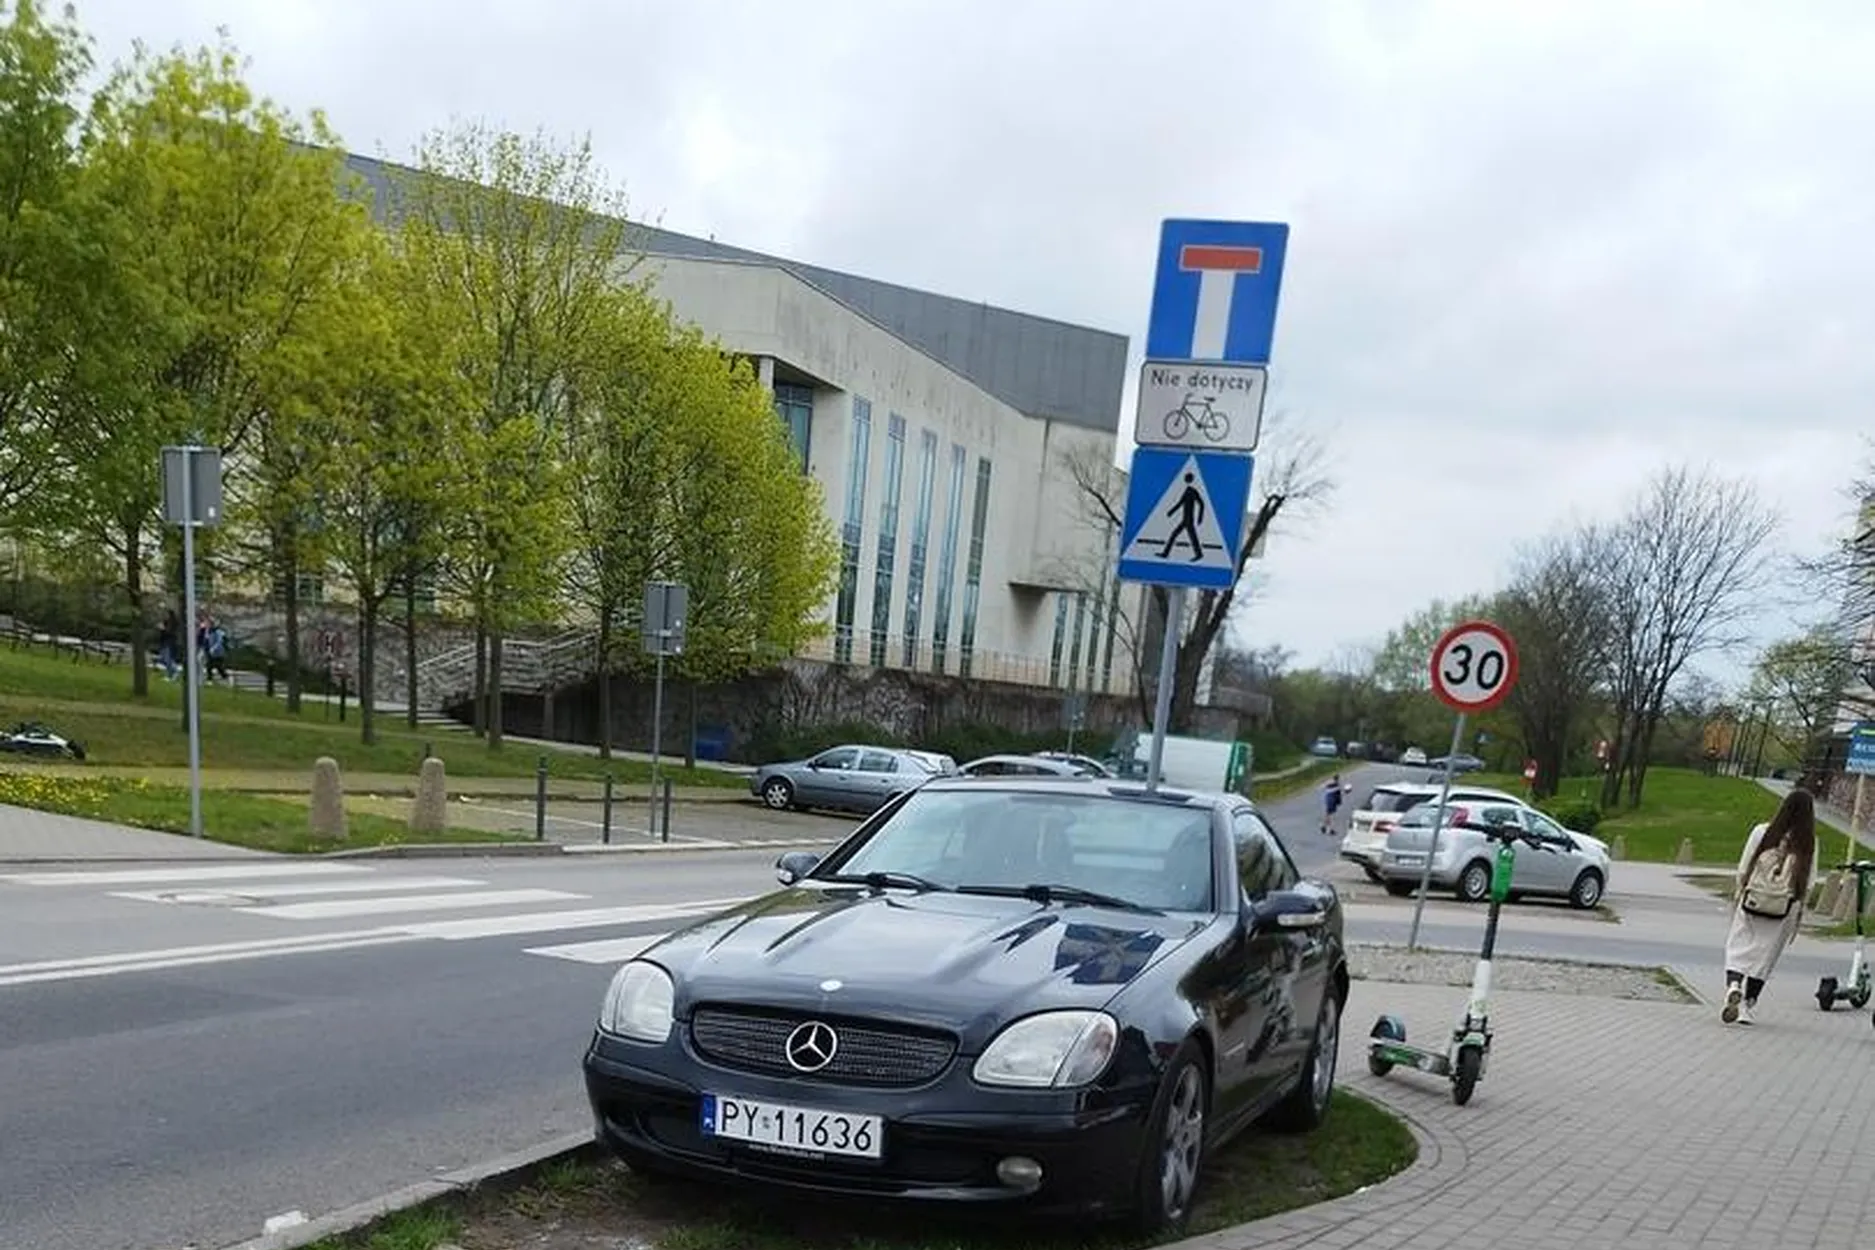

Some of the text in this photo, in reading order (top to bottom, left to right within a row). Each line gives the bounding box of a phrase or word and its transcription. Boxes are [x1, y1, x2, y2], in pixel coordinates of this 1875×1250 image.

[1151, 369, 1253, 394] Nie dotyczy
[1444, 644, 1504, 690] 30
[721, 1101, 871, 1151] PY 11636
